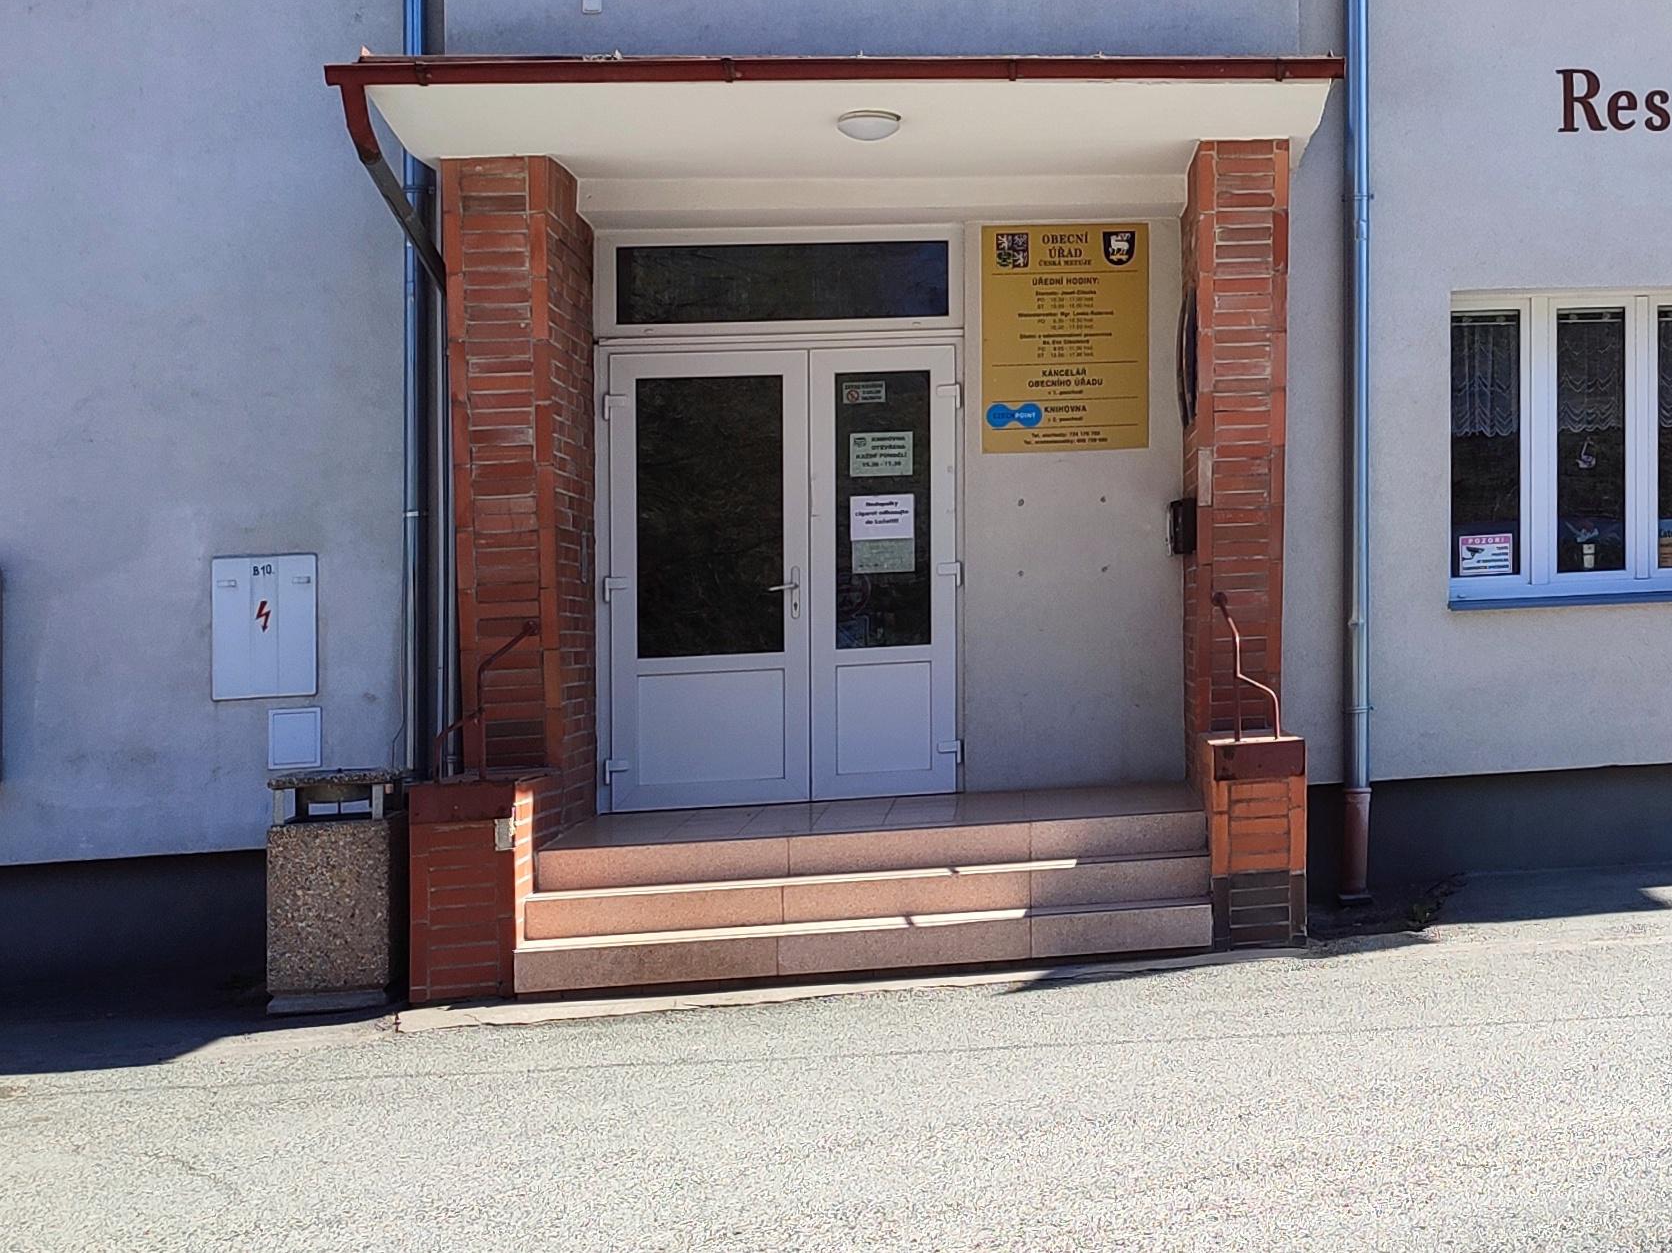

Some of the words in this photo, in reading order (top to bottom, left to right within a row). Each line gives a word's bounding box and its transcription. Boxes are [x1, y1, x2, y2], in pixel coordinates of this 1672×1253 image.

[1042, 231, 1088, 245] OBECNÍ
[1048, 246, 1083, 258] ÚŘAD
[1032, 276, 1064, 286] ÚŘEDNÍ
[1041, 368, 1087, 377] KANCELÁŘ
[1028, 379, 1072, 388] OBECNÍHO
[1044, 405, 1087, 413] KNIHOVNA
